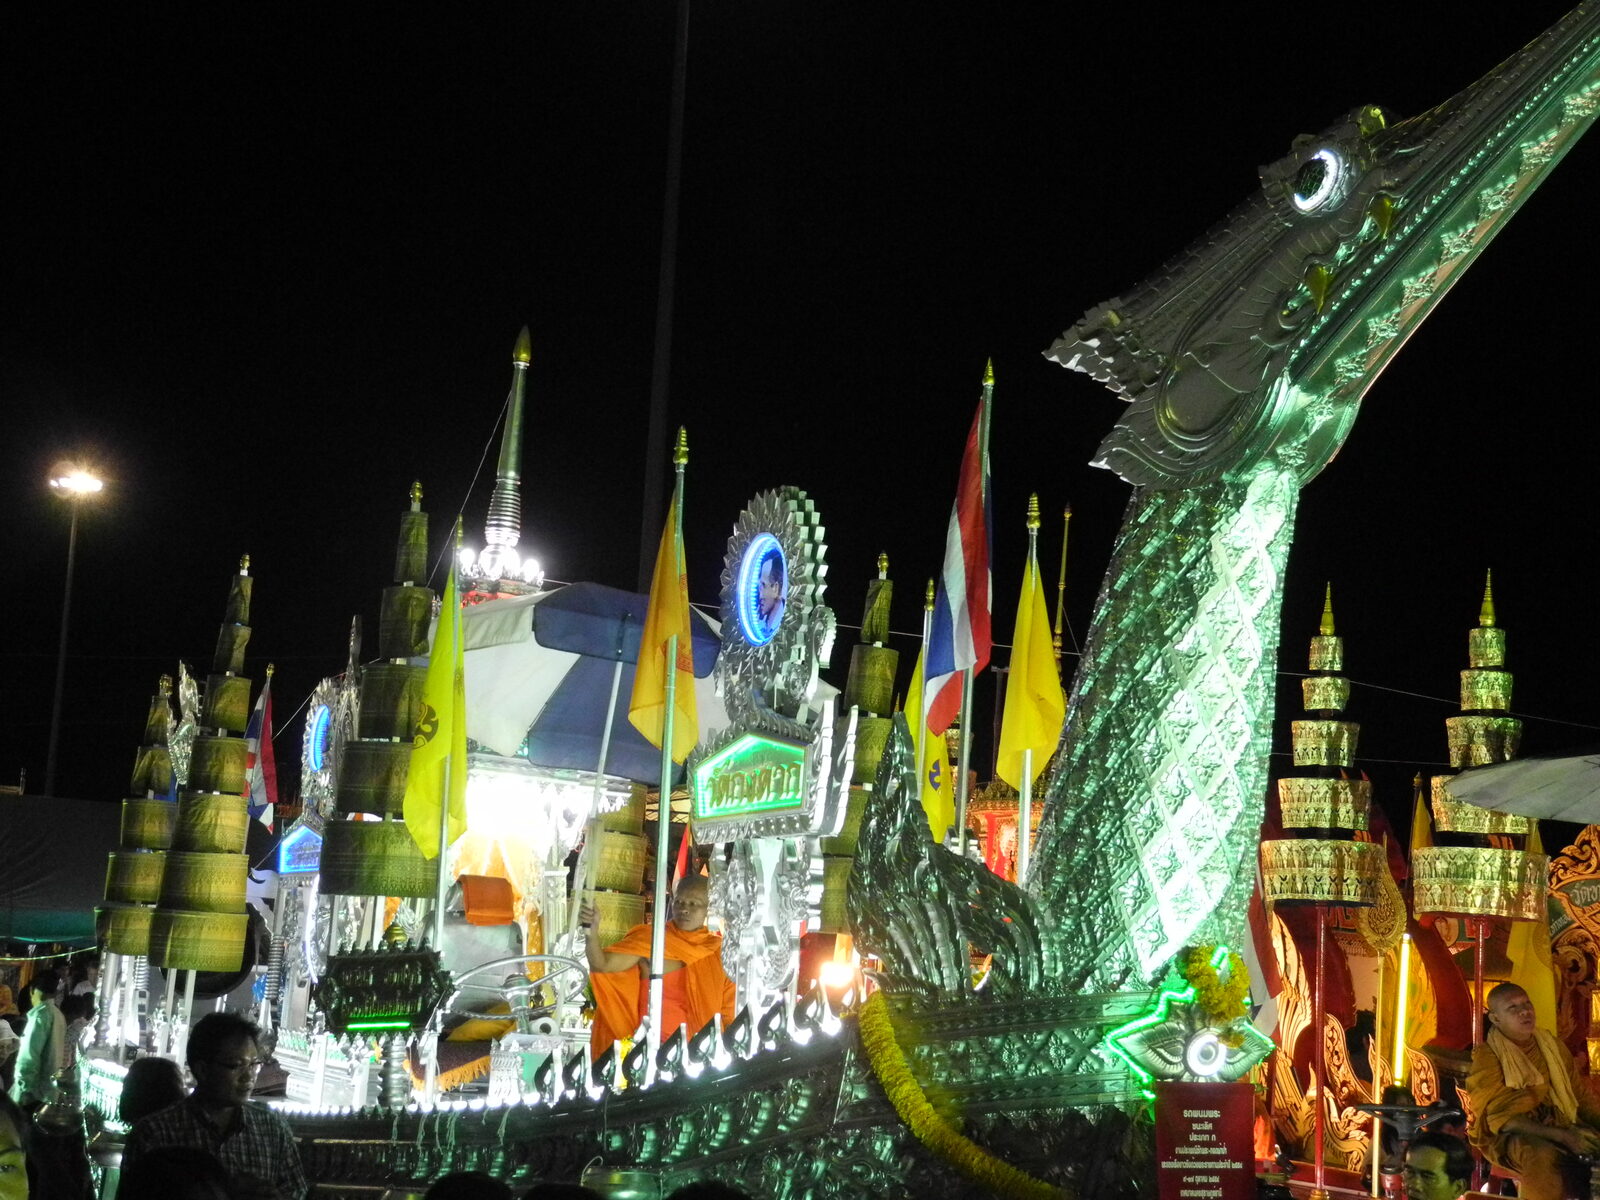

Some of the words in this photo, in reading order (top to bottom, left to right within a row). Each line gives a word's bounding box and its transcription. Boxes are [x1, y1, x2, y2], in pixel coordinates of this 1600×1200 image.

[1183, 1109, 1221, 1118] รถพนมพระ
[1191, 1121, 1213, 1130] ชนะเลิศ
[1189, 1132, 1210, 1141] ประเภท
